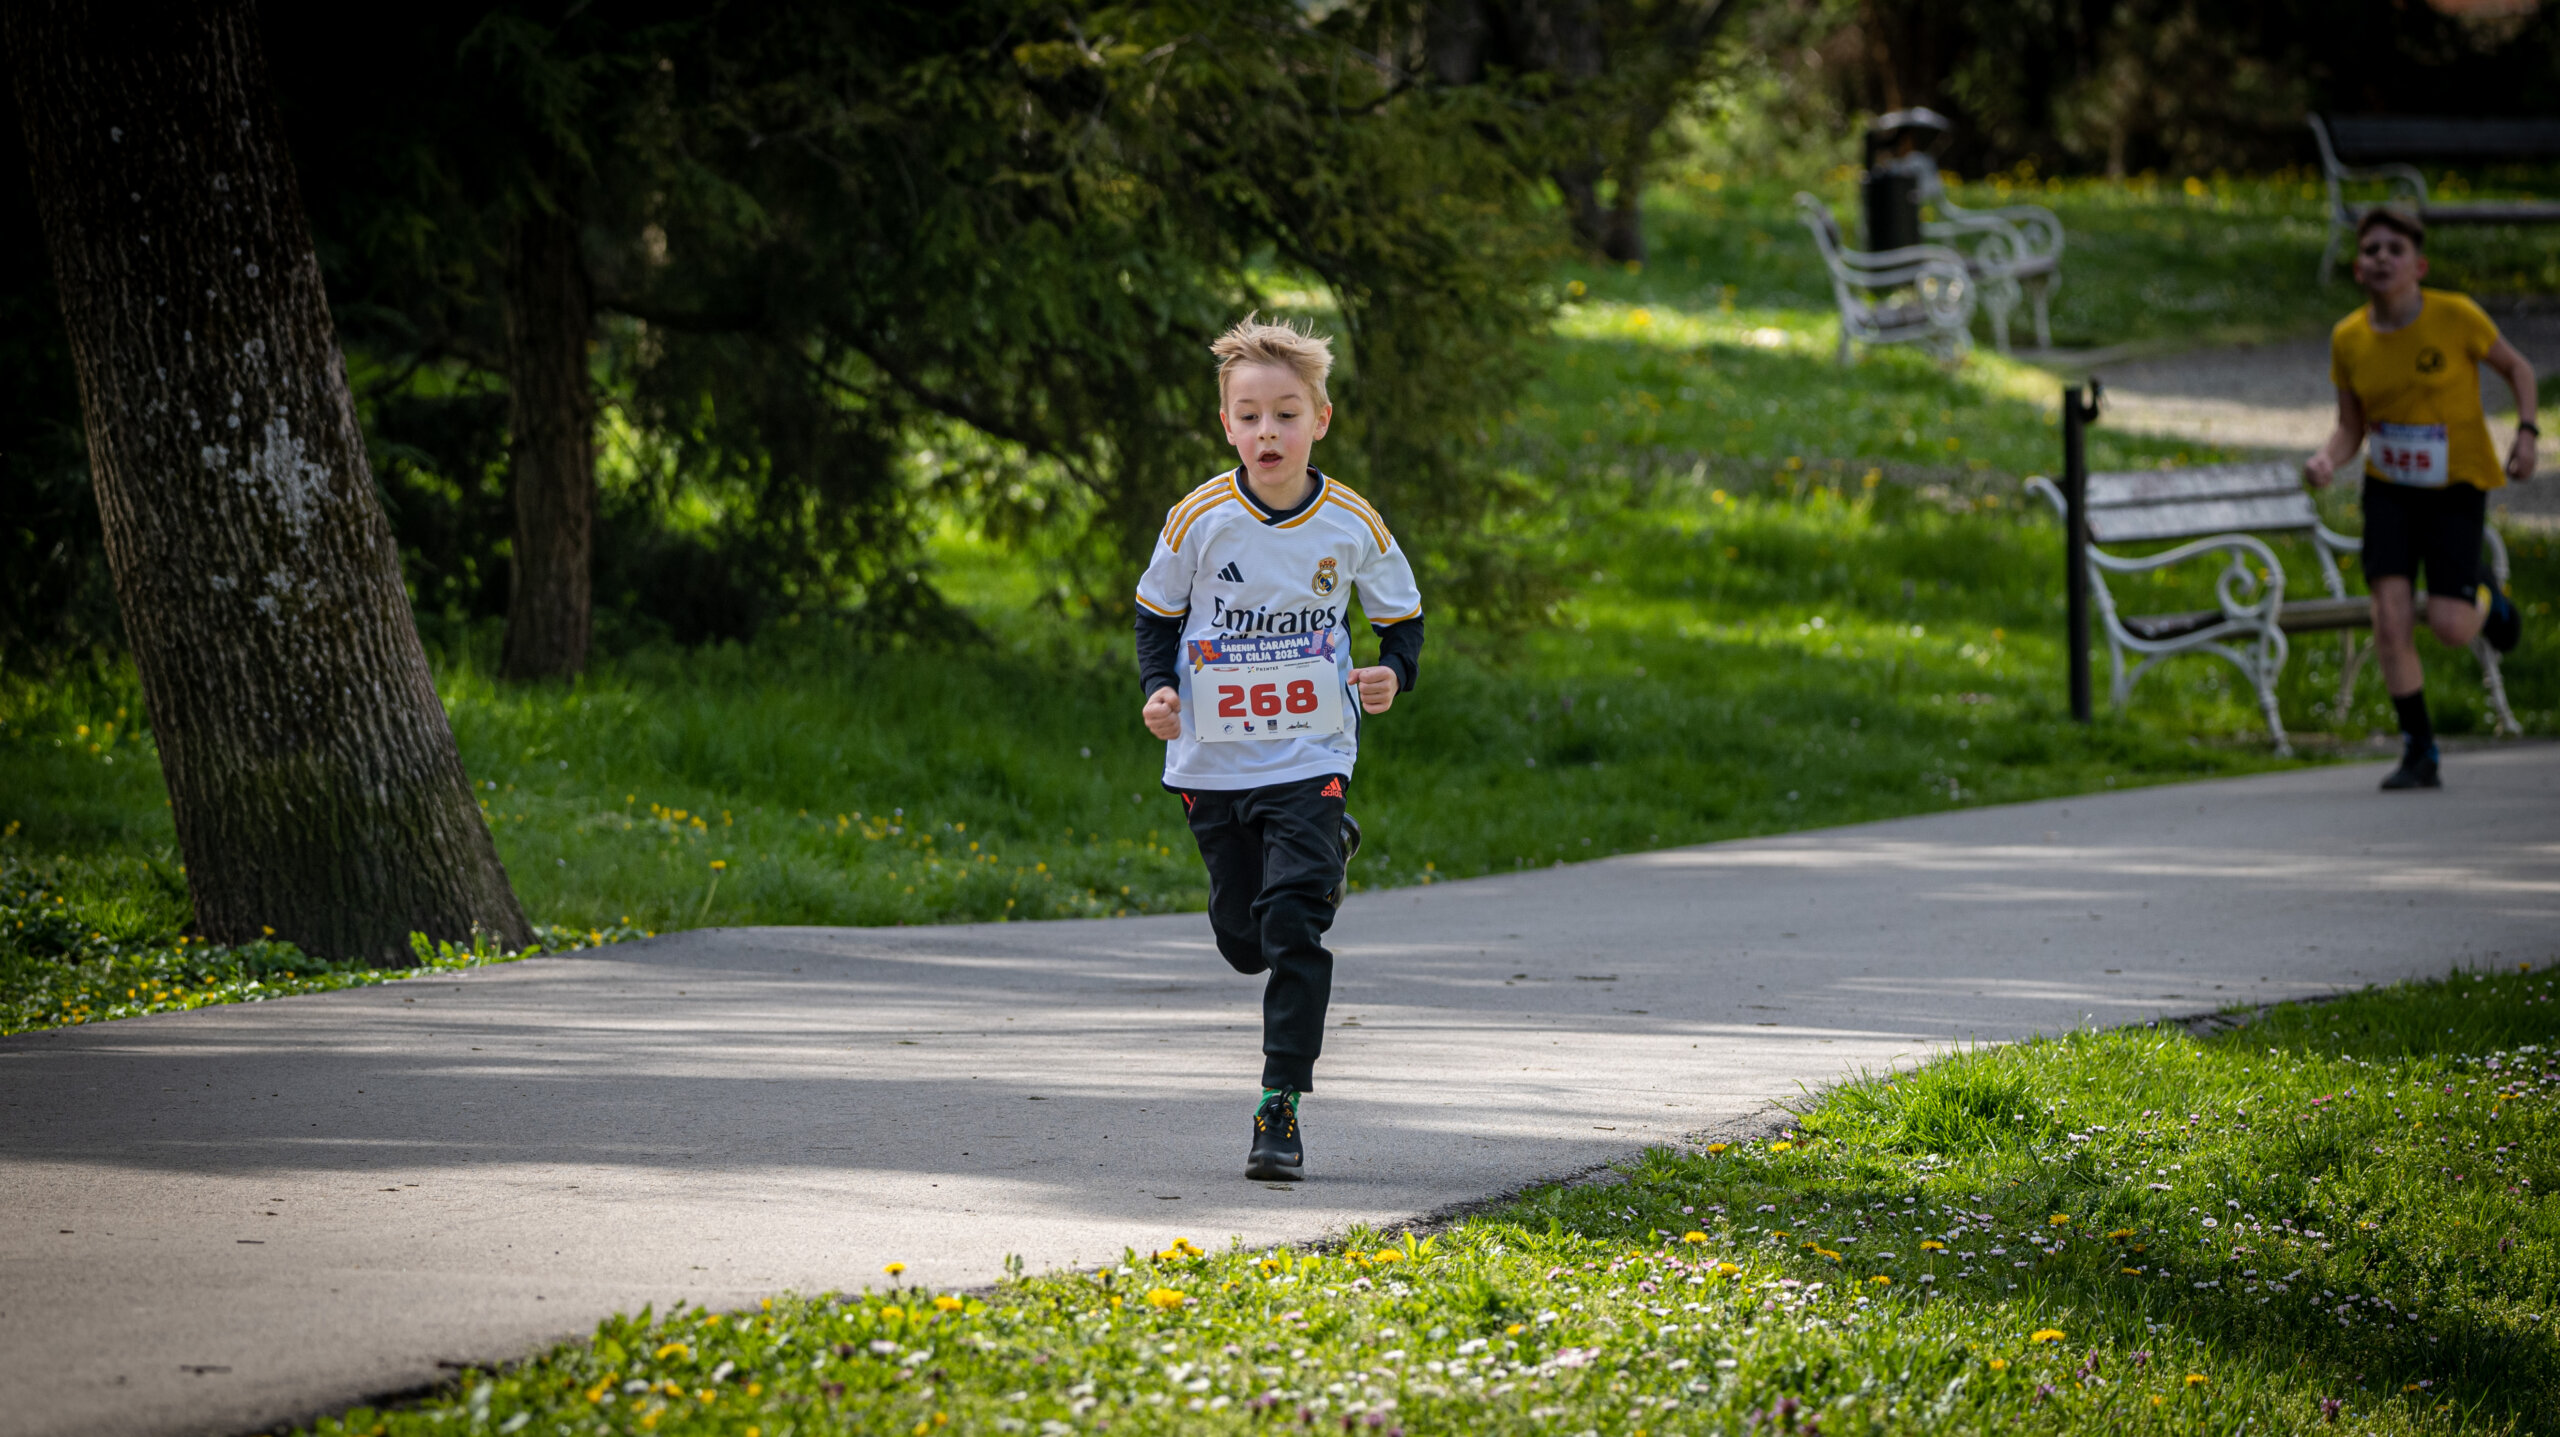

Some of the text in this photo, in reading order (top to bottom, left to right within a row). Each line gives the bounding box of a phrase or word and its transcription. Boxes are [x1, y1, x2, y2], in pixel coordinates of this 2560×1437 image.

[1211, 596, 1336, 634] Emirates
[1220, 637, 1310, 653] ŠARENIM ČARAPAMA
[1229, 648, 1301, 662] DO CILJA 2025.
[1218, 679, 1318, 718] 268
[1320, 789, 1343, 798] adida
